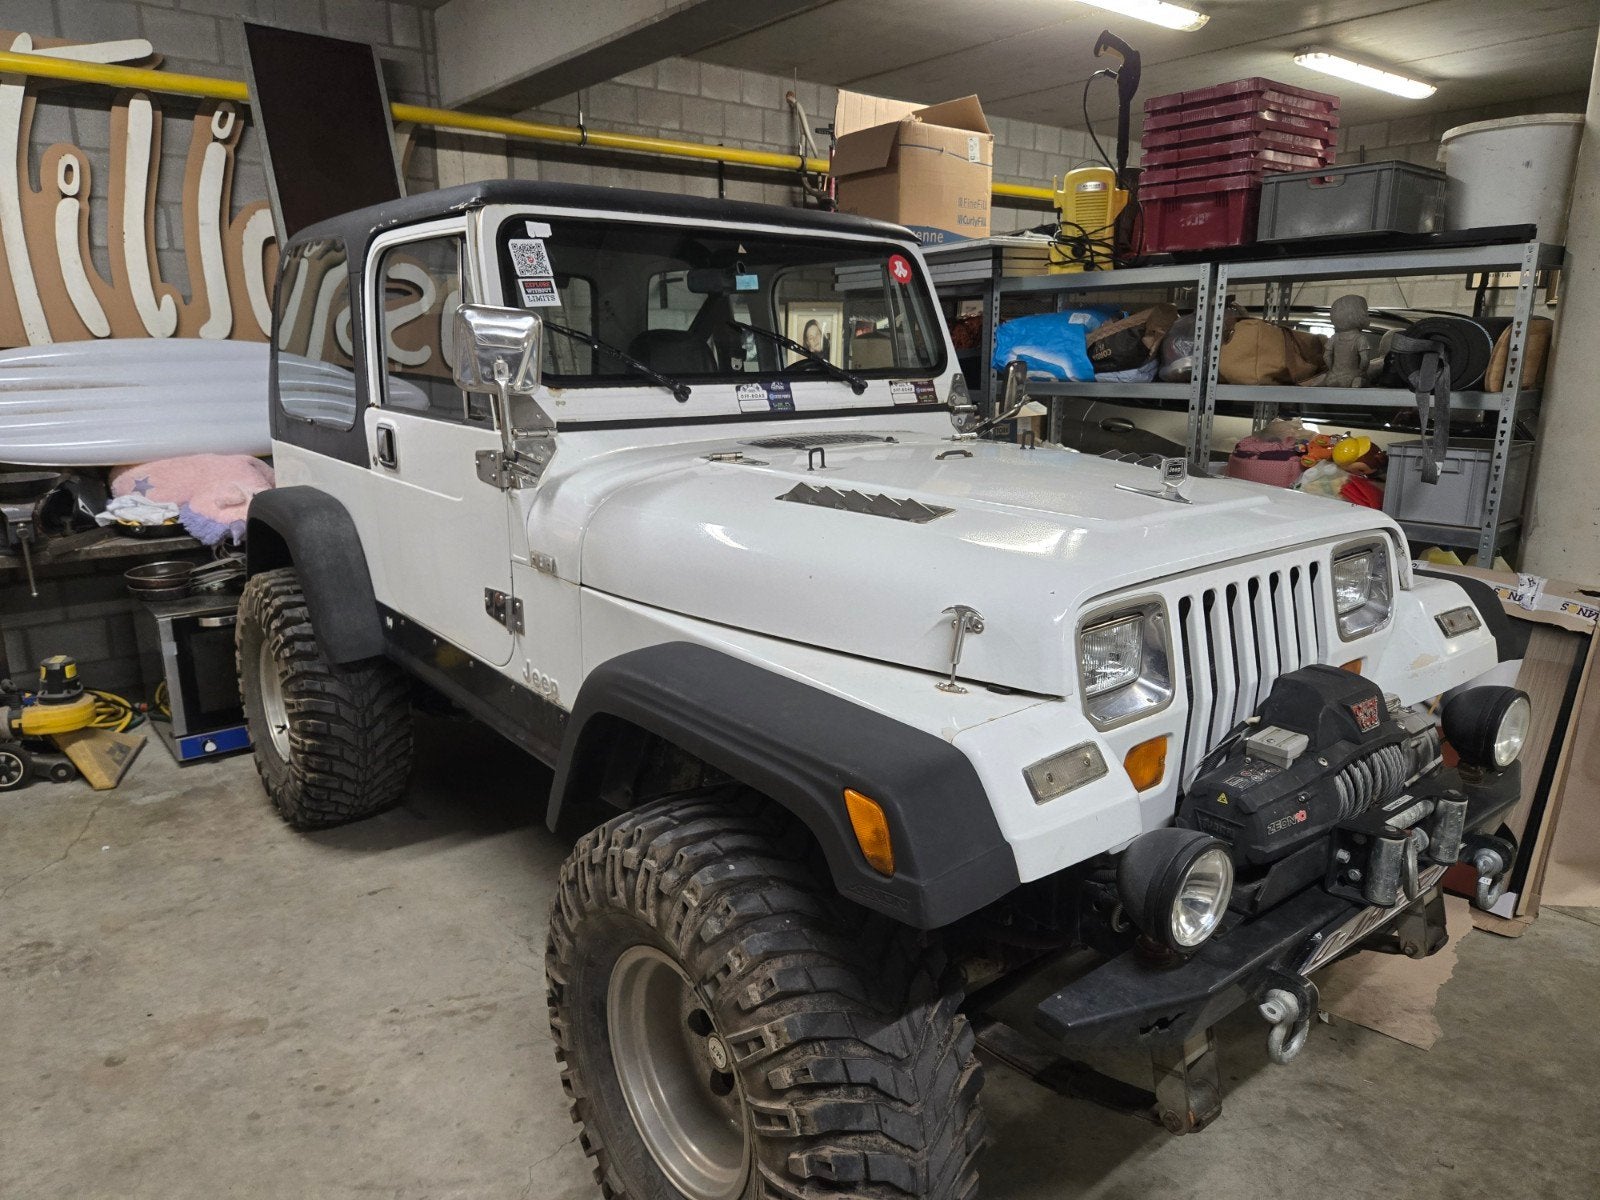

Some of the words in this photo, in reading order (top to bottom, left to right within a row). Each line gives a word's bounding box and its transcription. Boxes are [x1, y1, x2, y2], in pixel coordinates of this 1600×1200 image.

[913, 230, 944, 243] enne
[526, 294, 556, 303] LIMITS
[522, 659, 560, 698] Jeep
